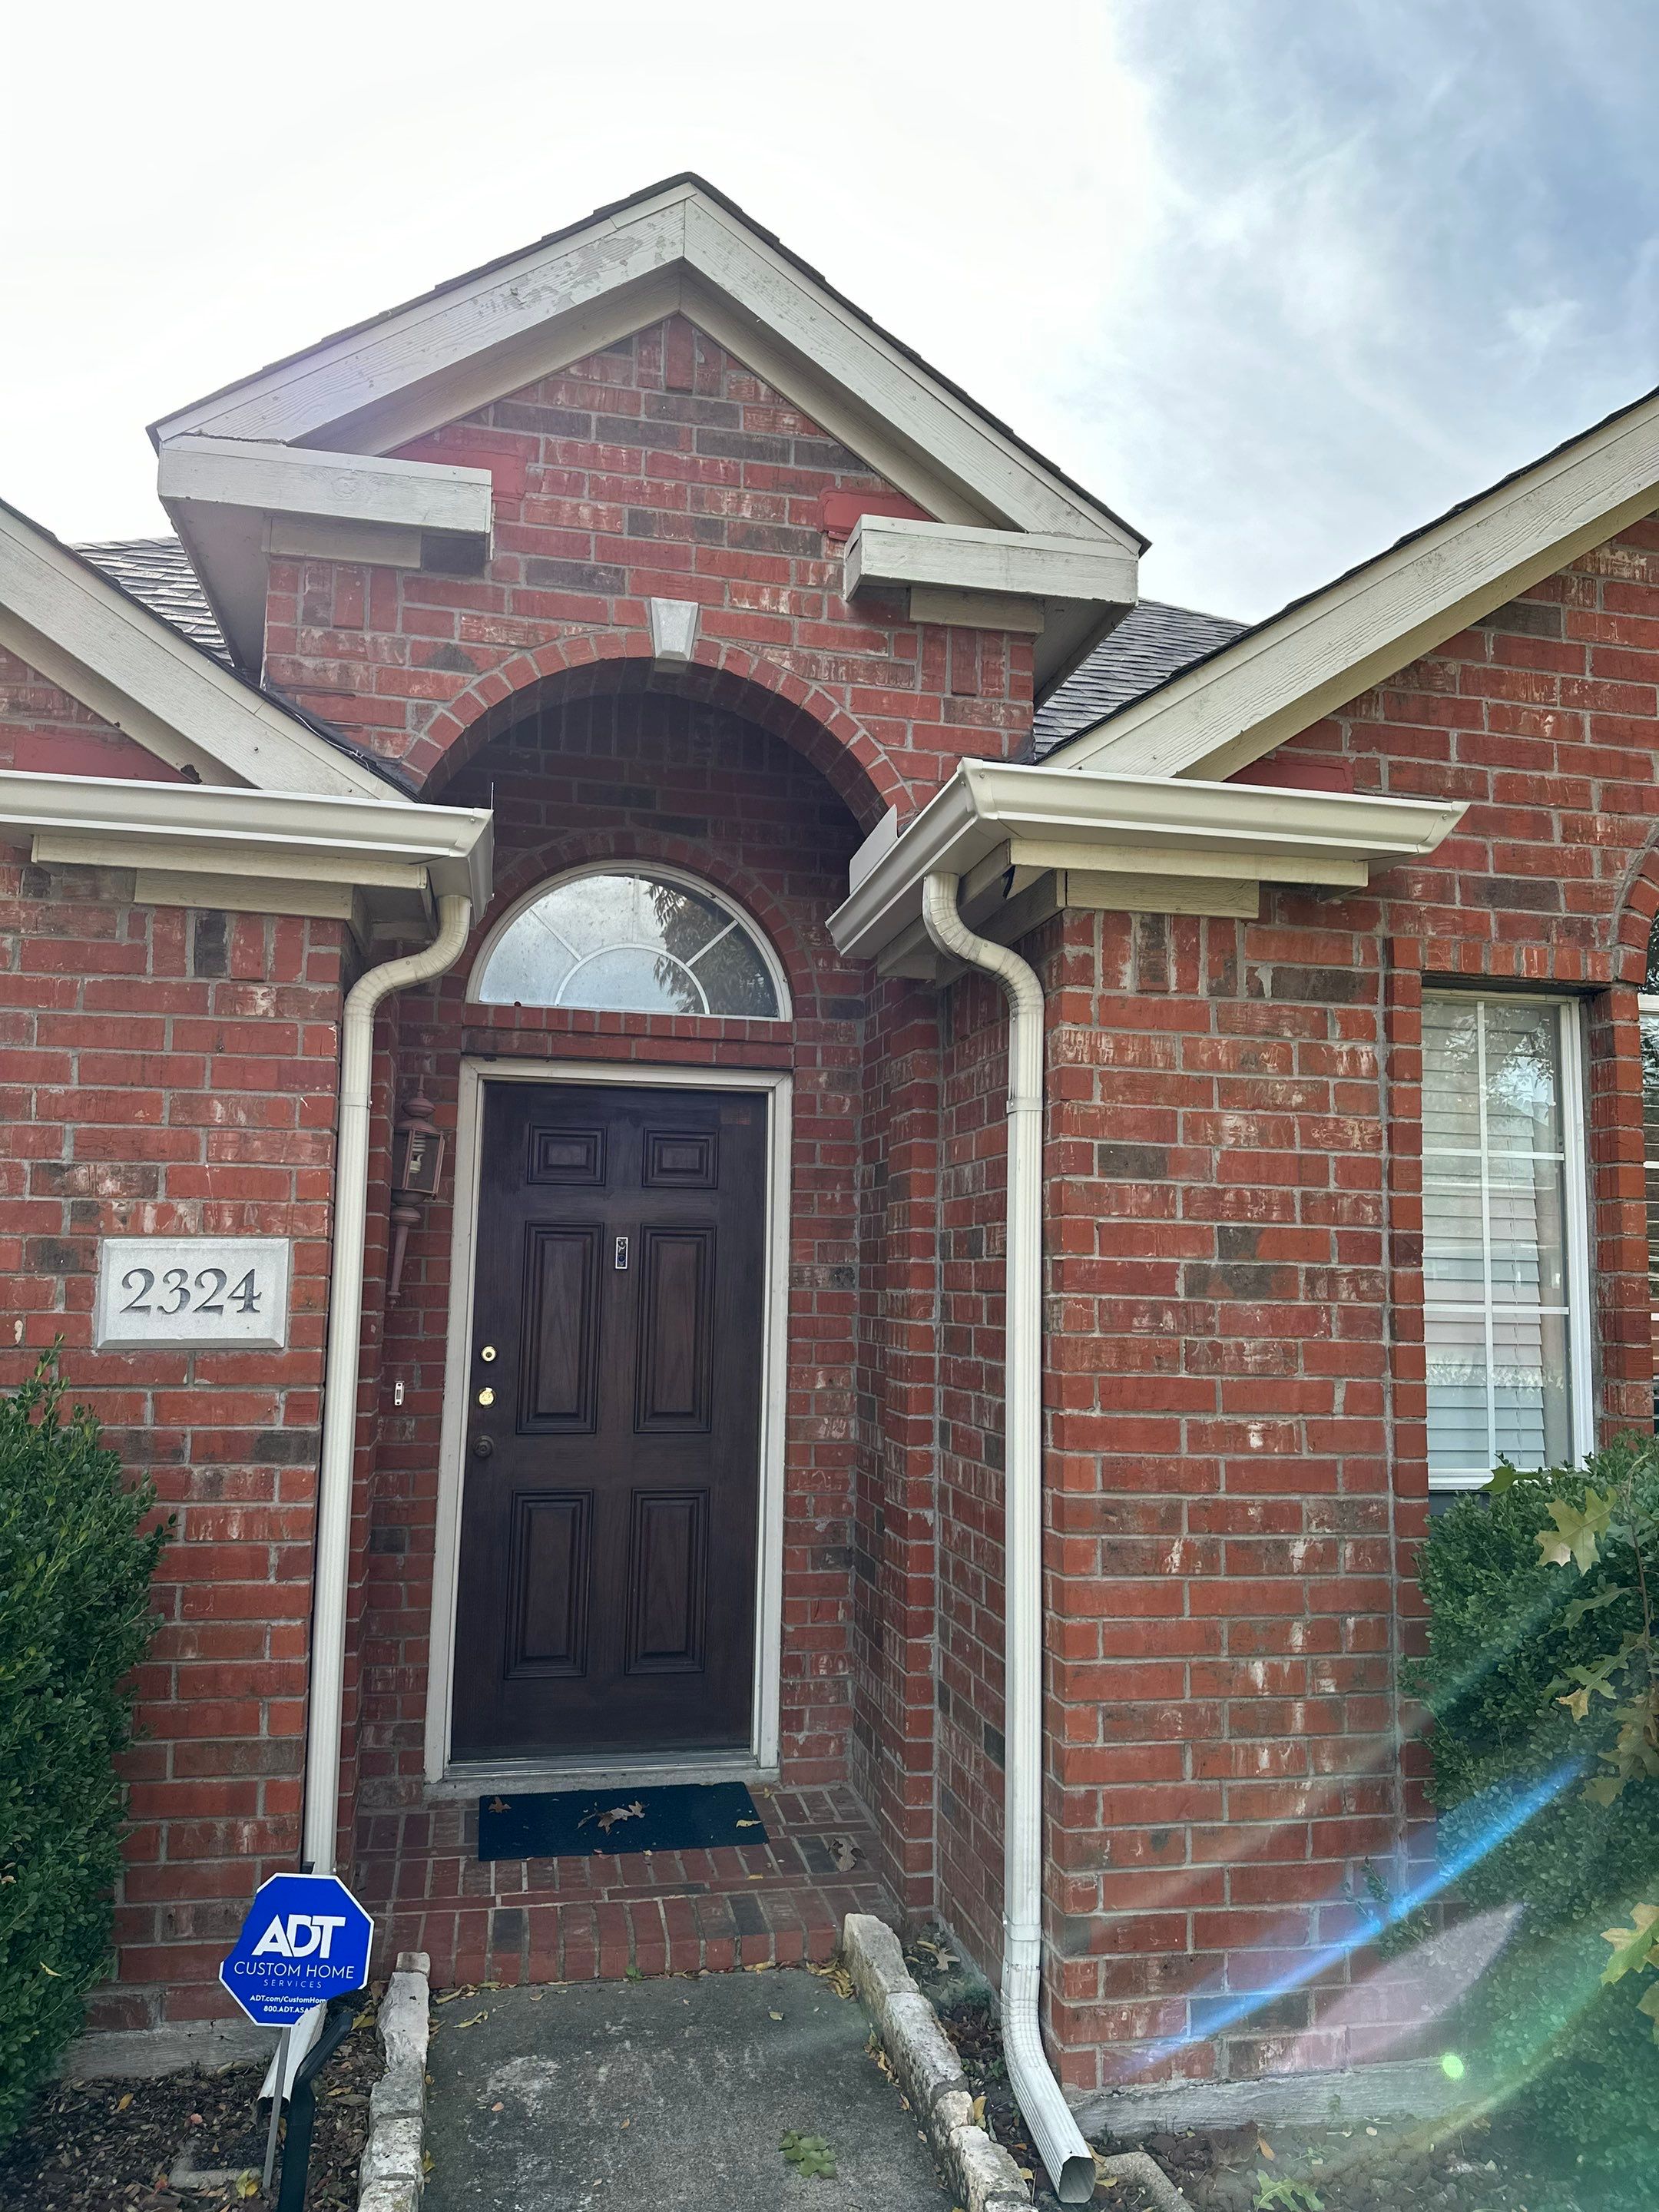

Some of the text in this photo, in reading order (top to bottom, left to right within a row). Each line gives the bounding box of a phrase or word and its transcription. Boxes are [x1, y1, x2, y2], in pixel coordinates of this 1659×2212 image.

[120, 1268, 262, 1315] 2324
[251, 1914, 346, 1959] ADT
[234, 1961, 355, 1979] CUSTOM HOME
[263, 1979, 322, 1988] SERVICES
